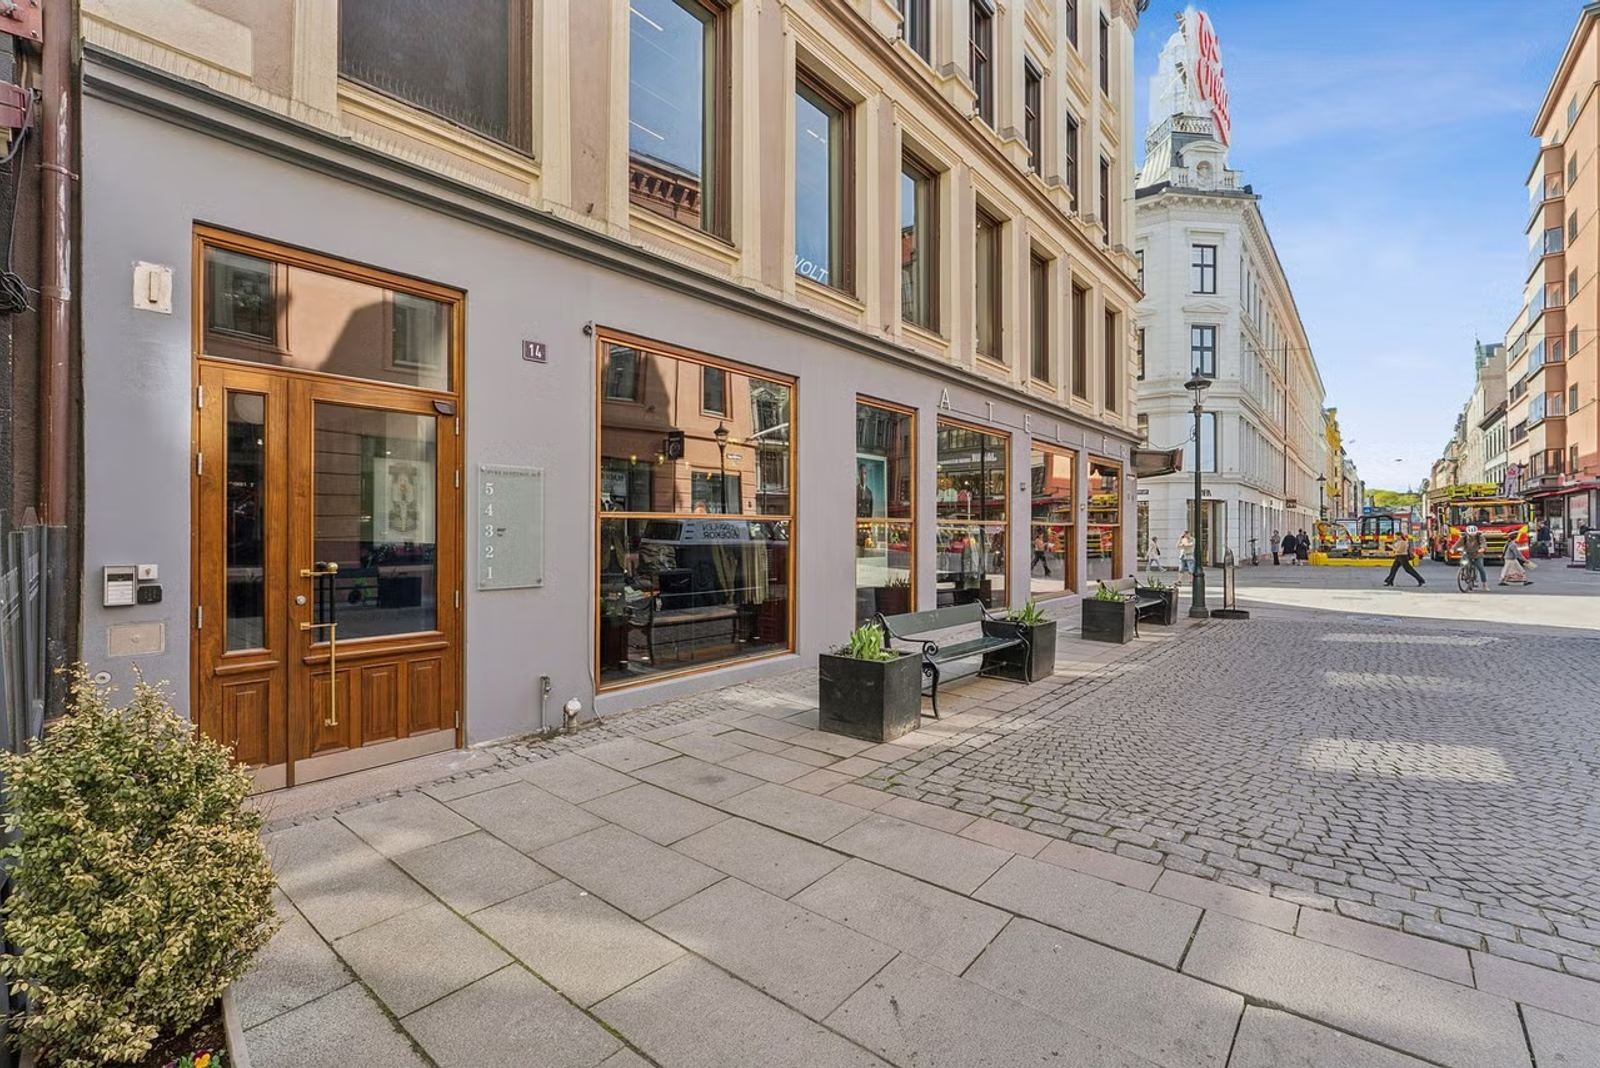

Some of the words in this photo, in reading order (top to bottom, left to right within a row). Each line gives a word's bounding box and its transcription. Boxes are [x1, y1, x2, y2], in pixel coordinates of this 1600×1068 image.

[529, 343, 542, 358] 14
[485, 482, 494, 496] 5
[485, 503, 494, 517] 4
[485, 524, 494, 537] 3
[485, 545, 494, 558] 2
[487, 566, 493, 579] 1
